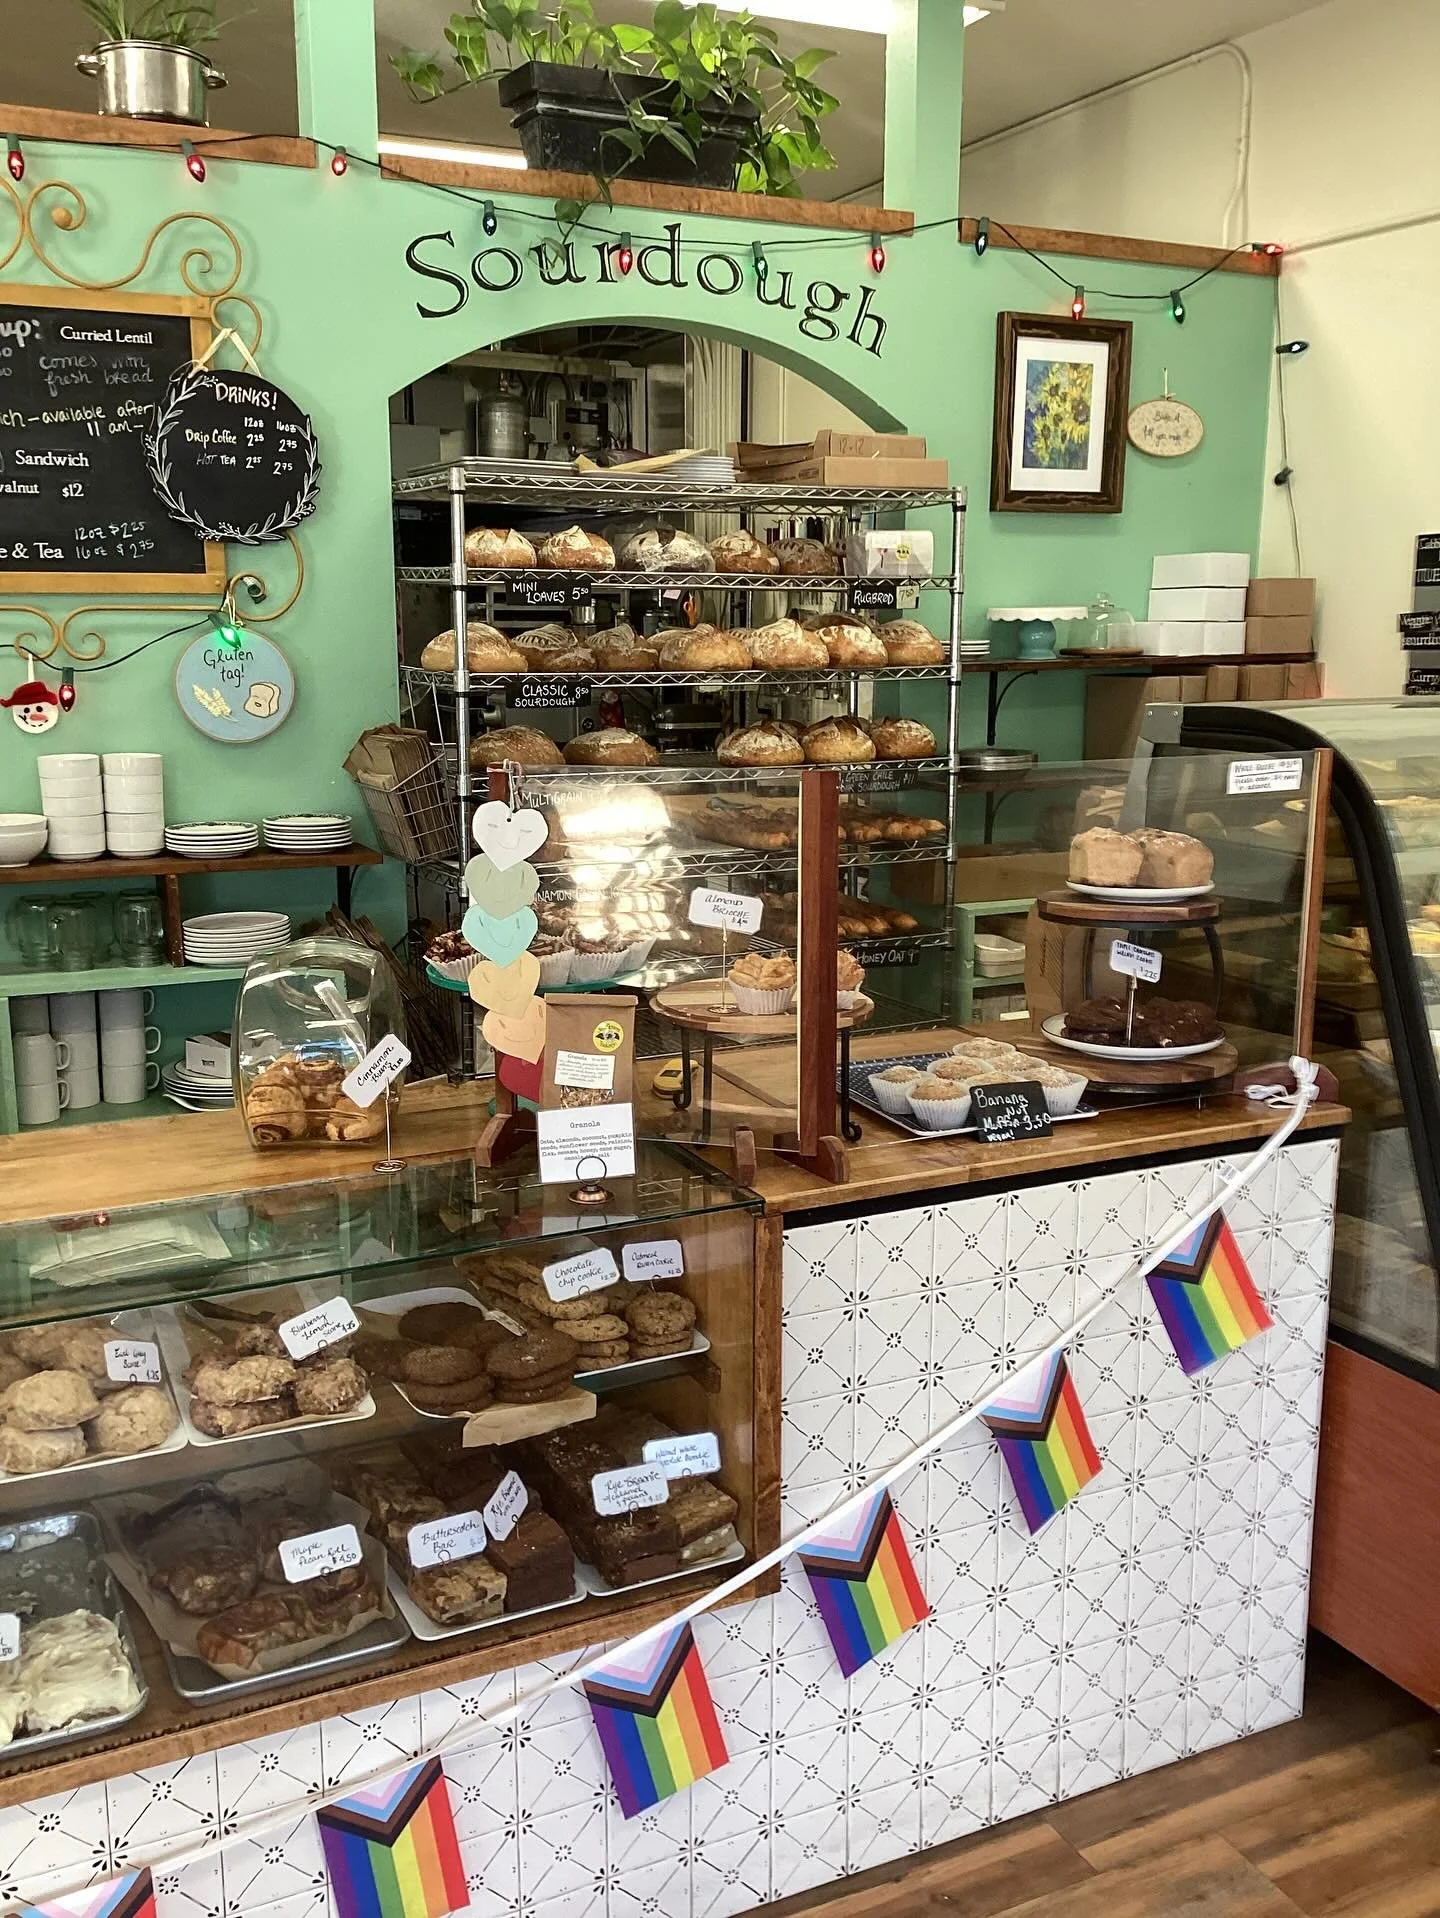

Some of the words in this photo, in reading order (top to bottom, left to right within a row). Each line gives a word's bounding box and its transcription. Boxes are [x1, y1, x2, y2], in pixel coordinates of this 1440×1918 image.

[405, 222, 883, 359] Sourdough
[60, 326, 113, 342] Curried
[116, 329, 153, 344] Lentil
[39, 354, 97, 370] comes
[44, 370, 93, 397] fresh
[103, 369, 154, 385] bread
[117, 400, 153, 417] after
[86, 421, 101, 437] 11
[211, 428, 237, 444] Coffee
[15, 450, 89, 467] Sandwich
[219, 455, 236, 466] TEA
[62, 483, 84, 498] $12
[12, 543, 29, 559] &
[33, 543, 64, 559] Tea
[512, 581, 537, 592] MINI
[525, 590, 565, 604] LOAVES
[203, 649, 254, 669] Gluten
[220, 663, 245, 688] tag!
[522, 684, 569, 697] CLASSIC
[514, 696, 576, 707] SOURDOUGH
[872, 770, 893, 780] CHILE
[522, 791, 583, 808] MULTIGRAIN
[857, 951, 887, 964] HONEY
[888, 949, 906, 962] OAT
[356, 1046, 394, 1086] Cinnamon
[975, 1088, 1029, 1108] Banana
[569, 1120, 601, 1128] Granola
[1023, 1113, 1051, 1131] 3.50
[555, 1260, 593, 1278] Chocolate
